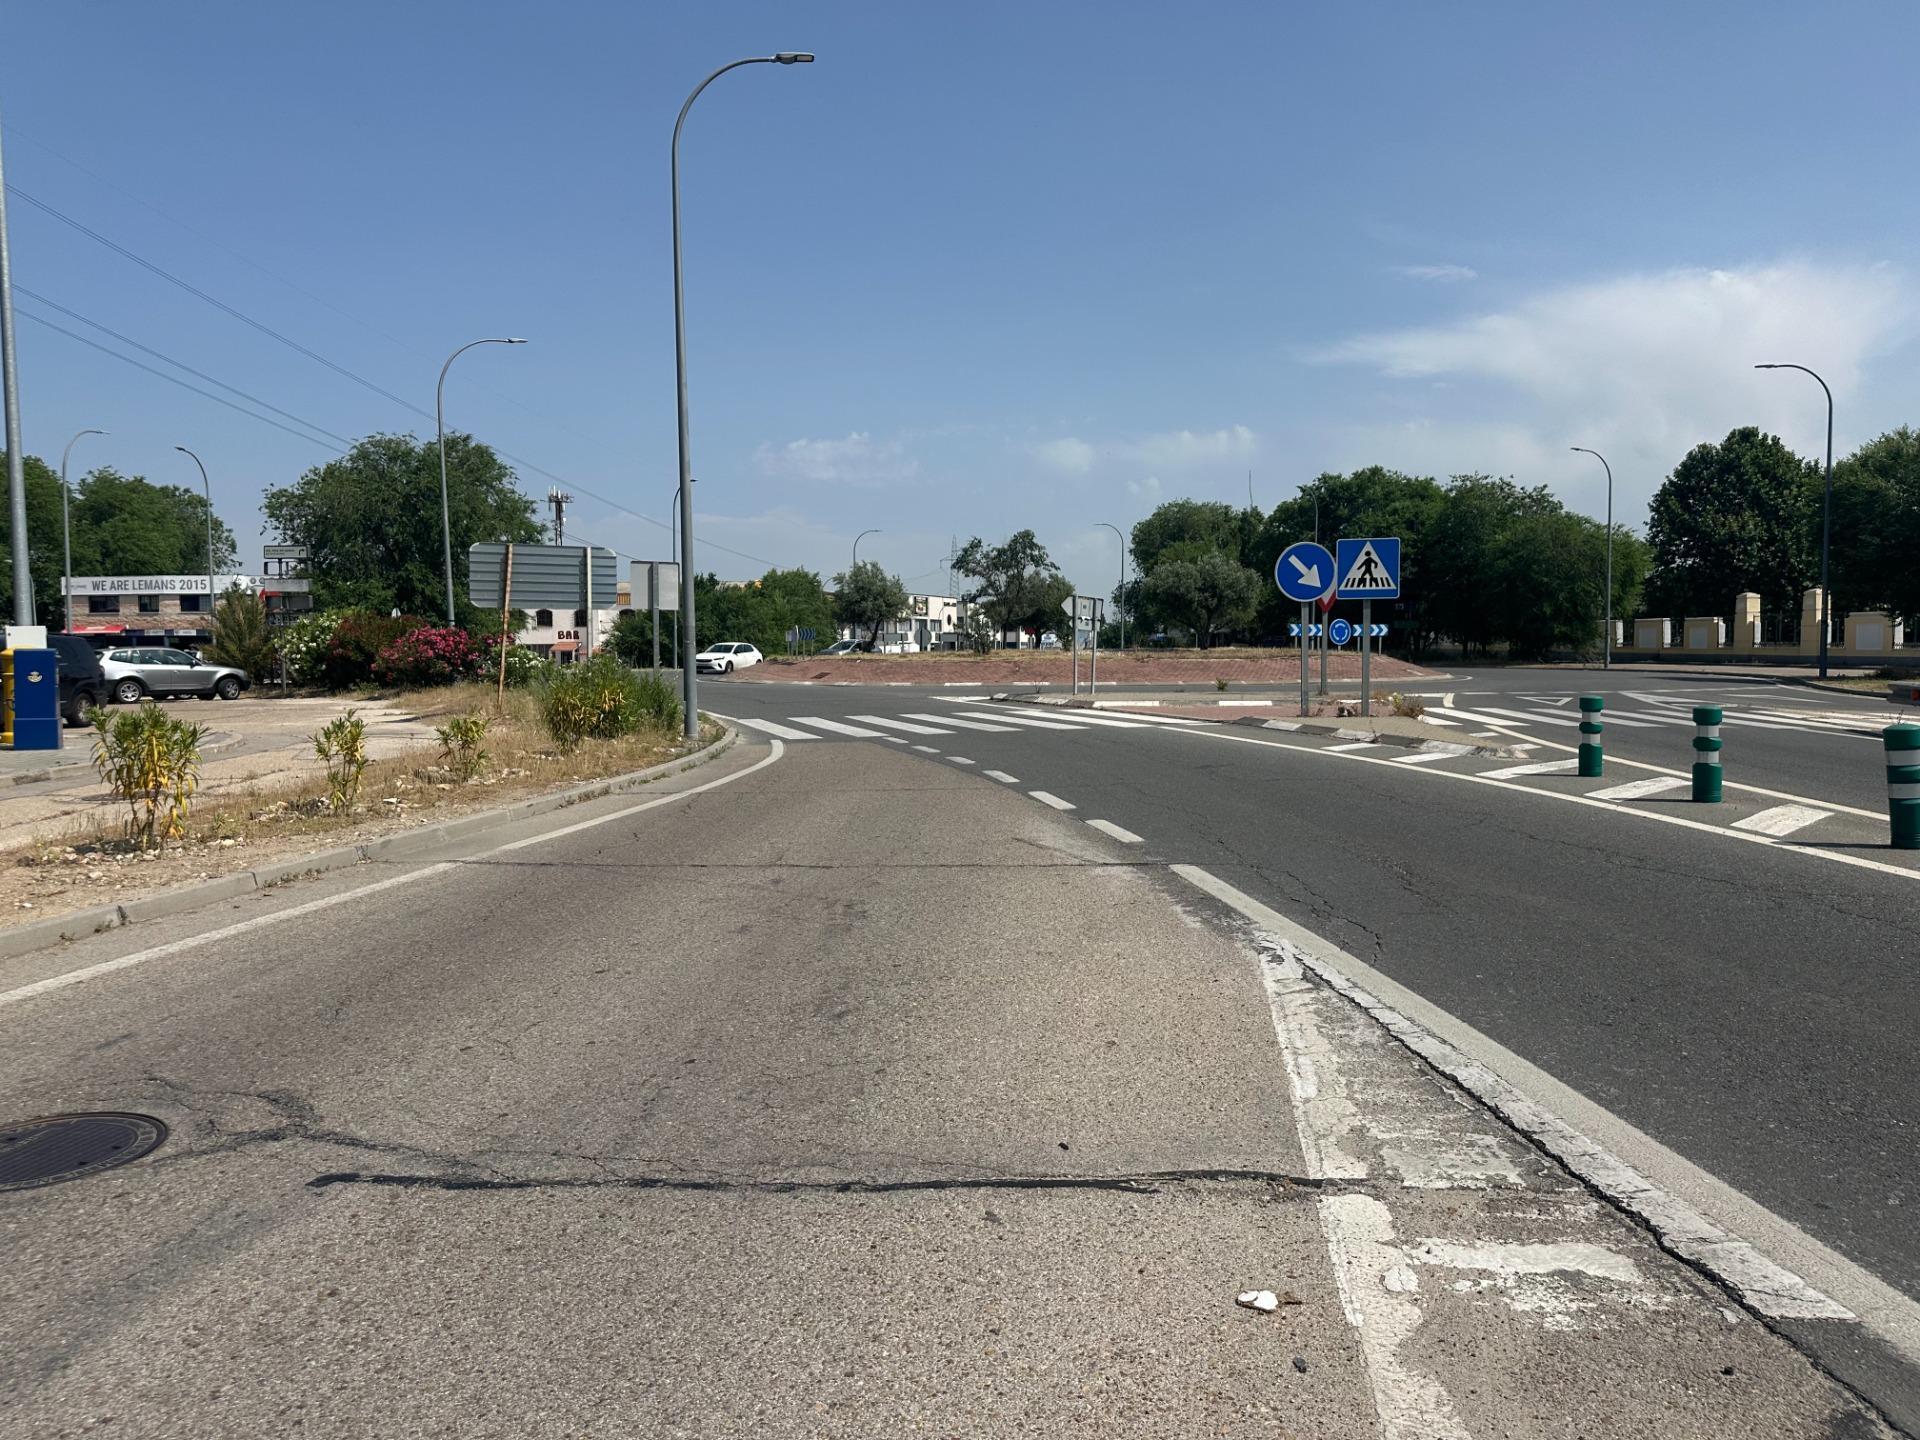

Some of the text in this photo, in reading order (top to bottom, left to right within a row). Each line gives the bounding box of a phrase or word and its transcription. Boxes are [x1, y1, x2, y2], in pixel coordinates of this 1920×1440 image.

[92, 580, 107, 591] WE
[109, 580, 129, 591] ARE
[132, 579, 176, 590] LEMANS
[179, 579, 207, 590] 2015
[557, 630, 580, 640] BAR
